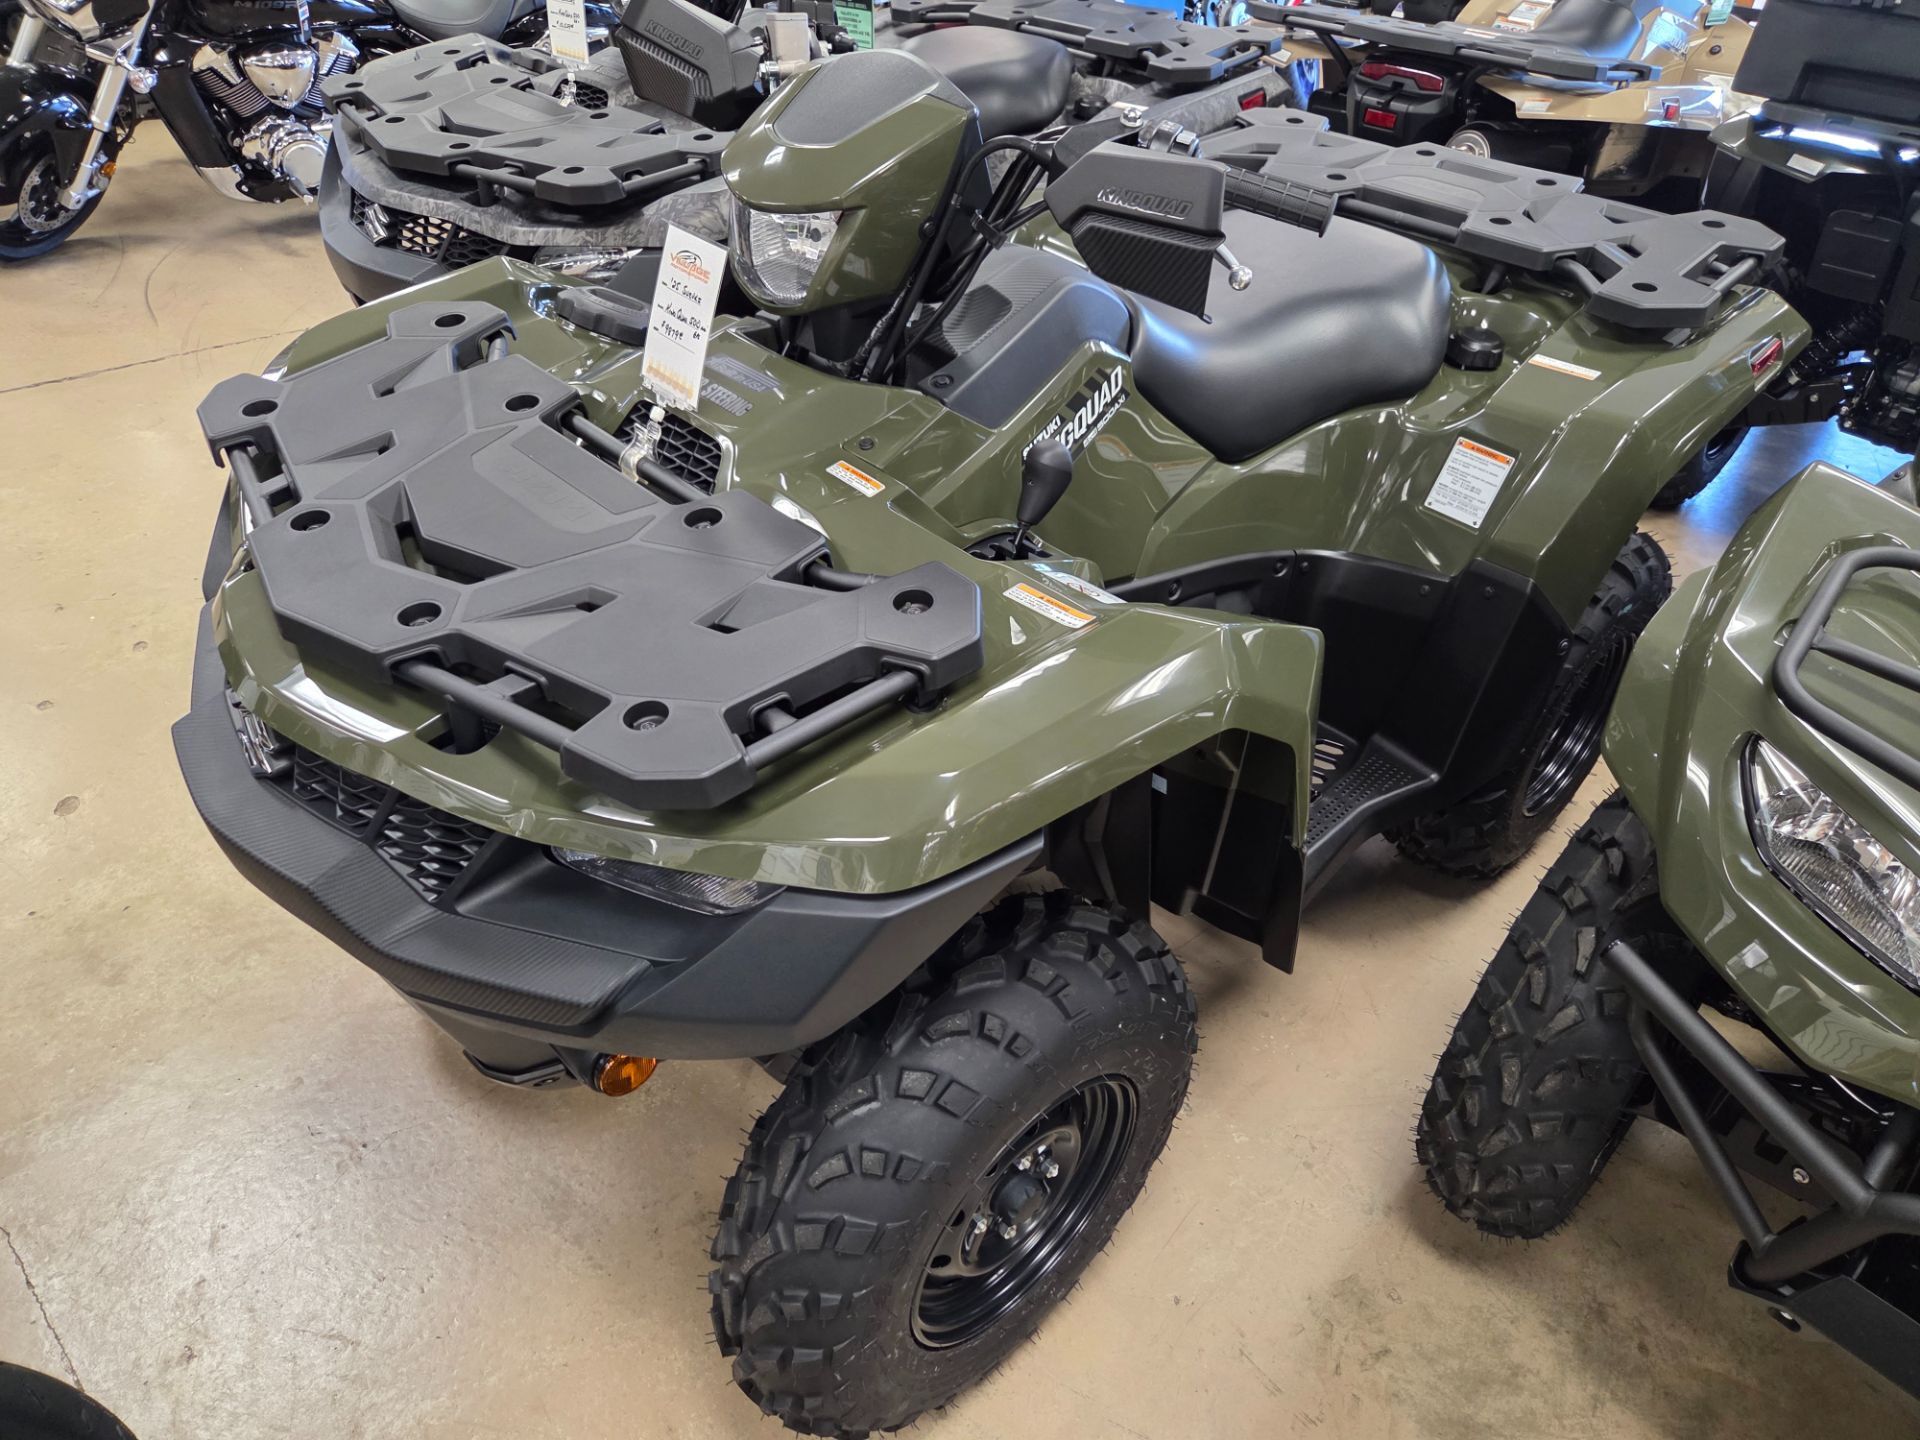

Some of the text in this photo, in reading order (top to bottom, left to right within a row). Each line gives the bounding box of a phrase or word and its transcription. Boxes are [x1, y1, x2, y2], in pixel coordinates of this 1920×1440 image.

[644, 19, 705, 61] KINGQUAD
[1096, 185, 1193, 220] KINGQUAD
[701, 383, 753, 417] STEERING
[1055, 365, 1123, 450] GQUAD
